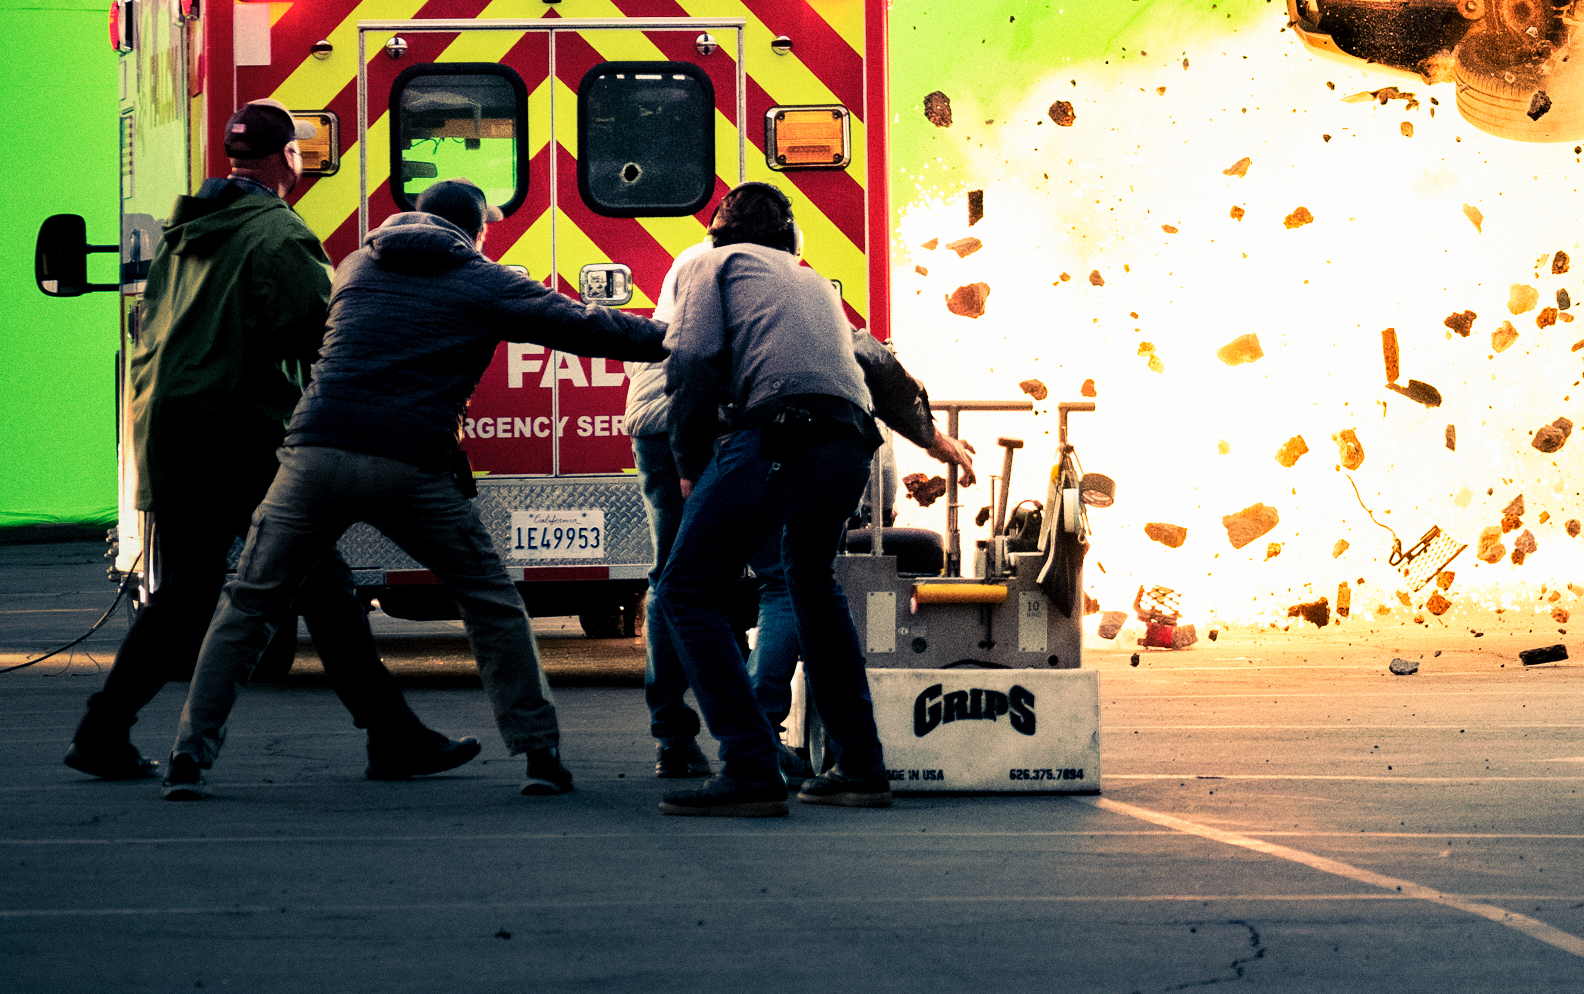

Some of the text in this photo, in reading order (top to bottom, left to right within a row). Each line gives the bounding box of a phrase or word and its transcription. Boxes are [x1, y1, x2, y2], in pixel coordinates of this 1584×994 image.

[508, 342, 631, 388] FAL
[464, 416, 629, 439] RGENCY SER
[533, 514, 581, 526] California
[515, 527, 600, 550] 1E49953
[886, 769, 905, 781] ADE
[922, 769, 945, 781] USA
